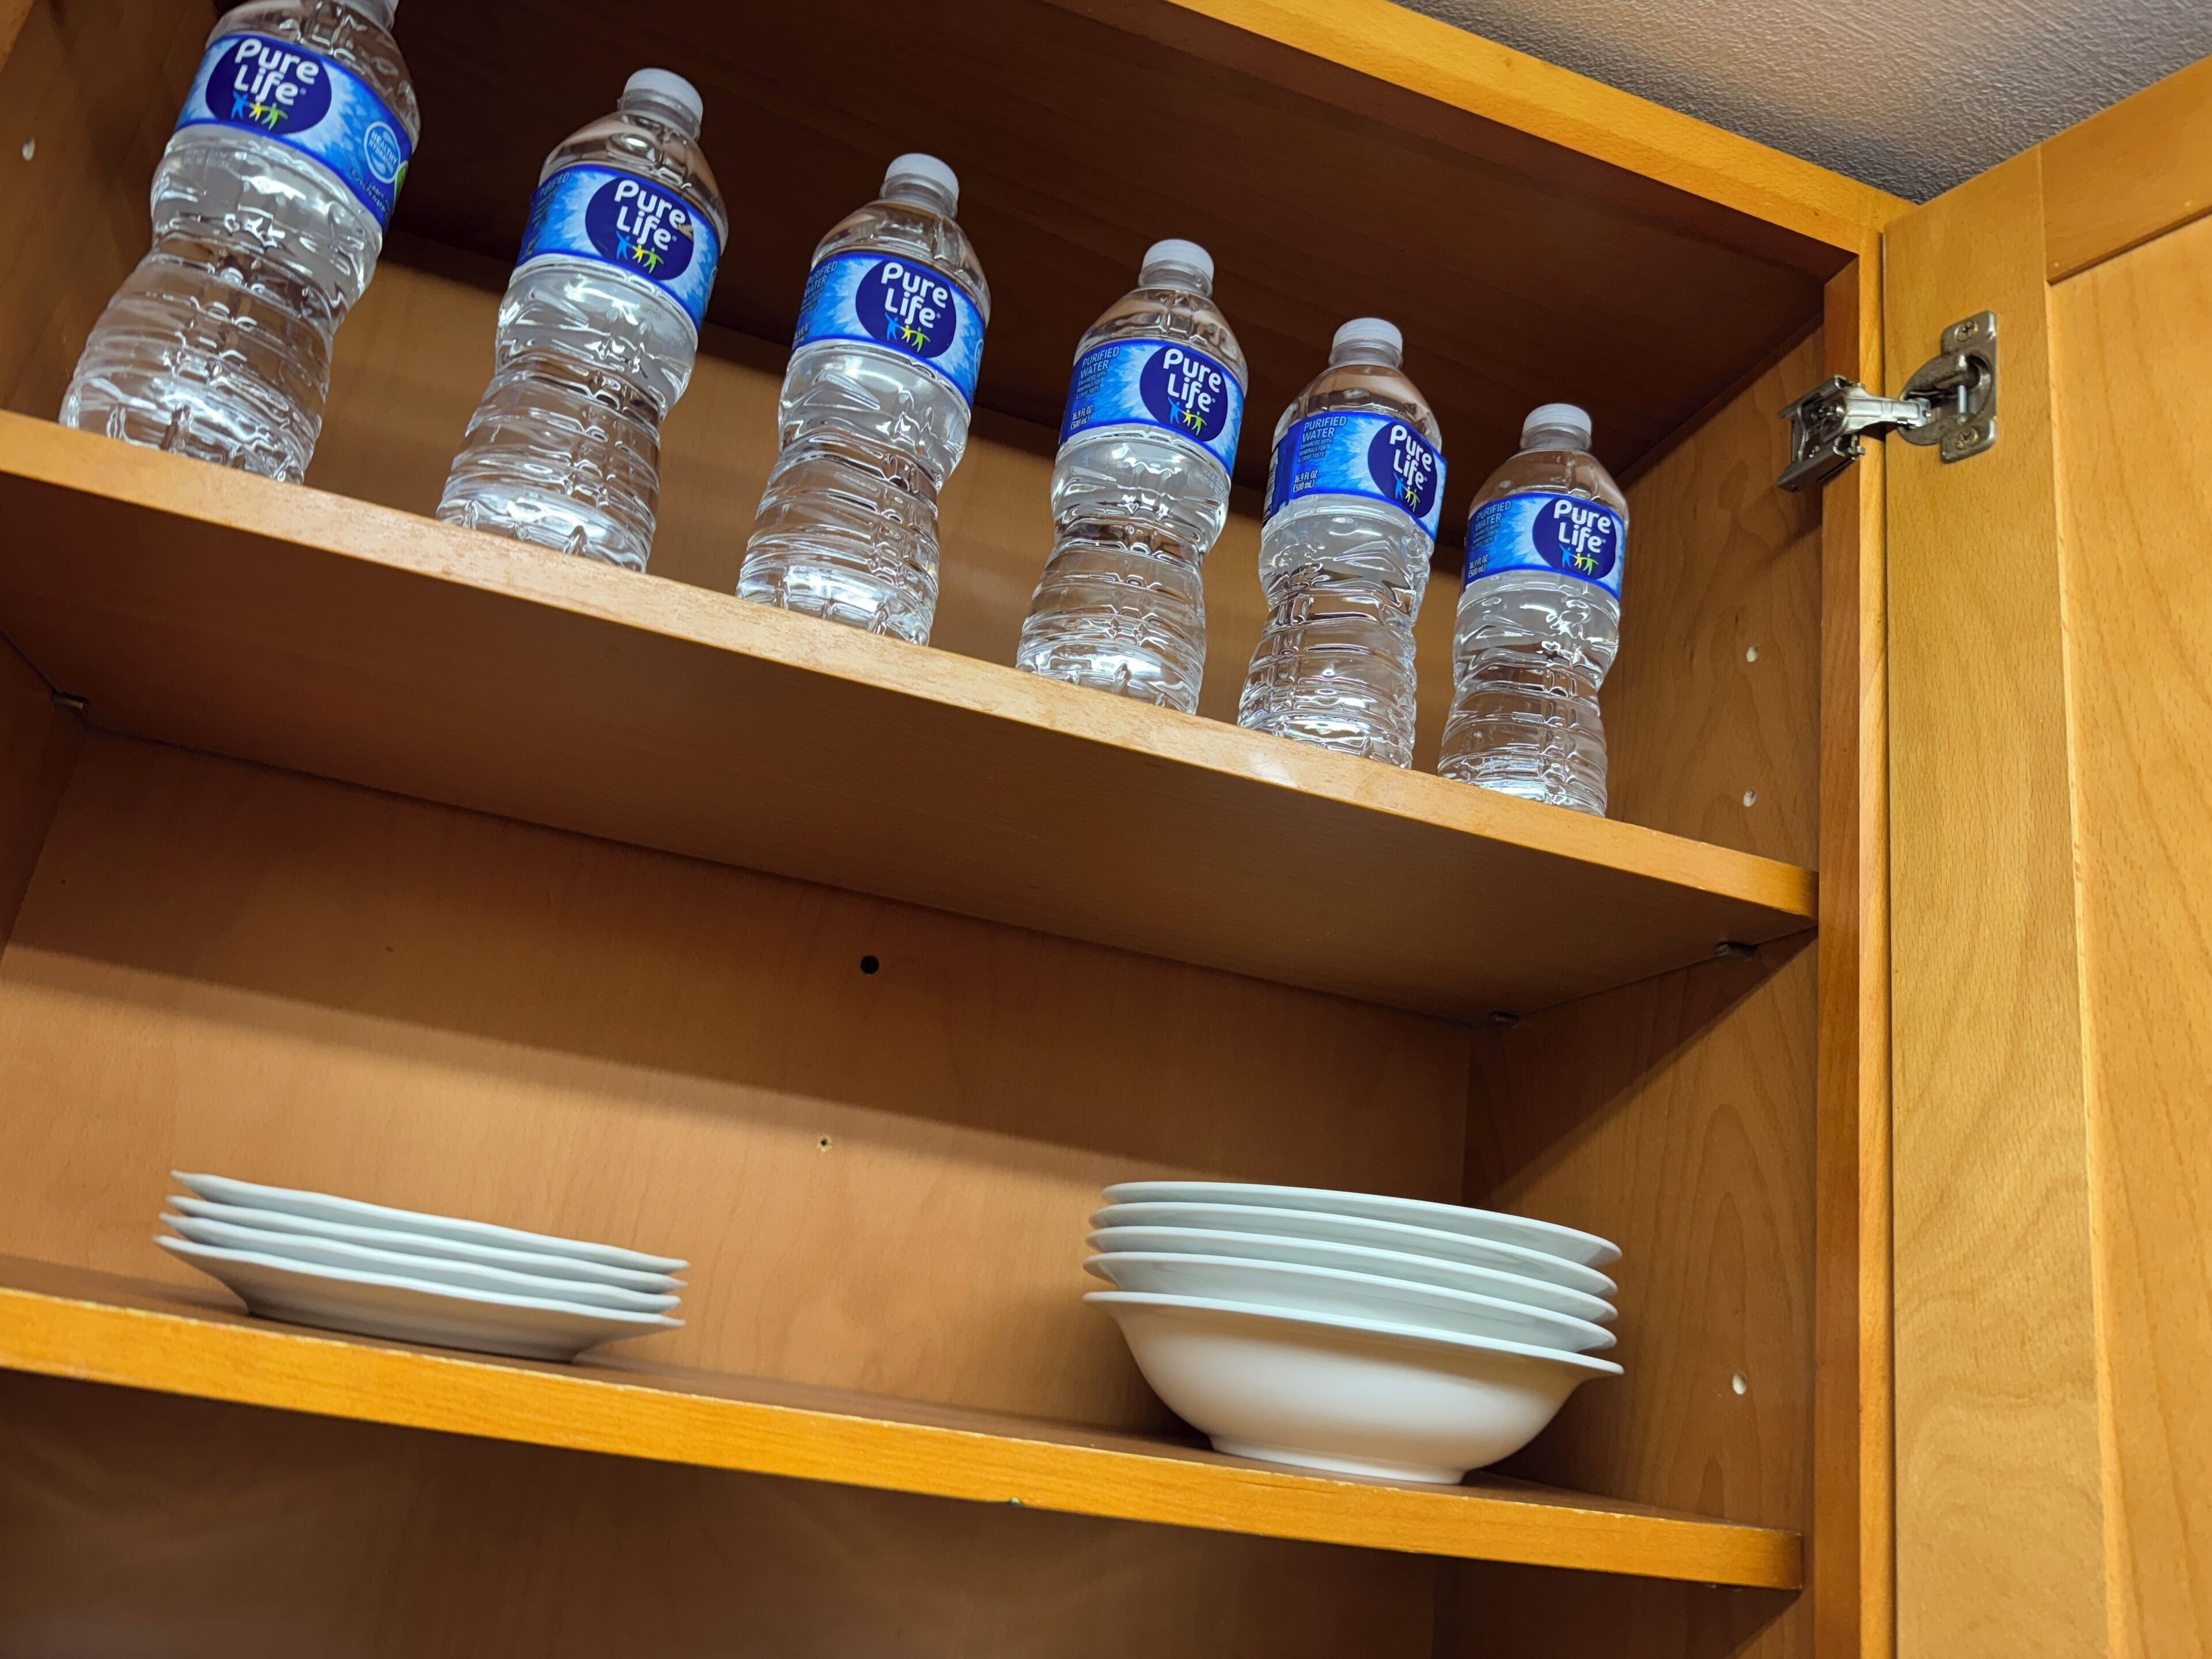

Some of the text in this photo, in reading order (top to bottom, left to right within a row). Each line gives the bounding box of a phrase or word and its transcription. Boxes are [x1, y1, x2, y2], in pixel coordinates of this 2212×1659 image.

[234, 39, 320, 85] Pure
[234, 65, 300, 105] Life
[372, 130, 398, 165] HEALTHY
[614, 179, 686, 229] Pure
[616, 206, 671, 251] Life
[806, 261, 838, 287] PURIFIED
[881, 262, 948, 308] Pure
[884, 287, 935, 328] Life
[1080, 359, 1109, 379] WATER
[1082, 346, 1120, 369] PURIFIED
[1163, 348, 1222, 393] Pure
[1167, 374, 1211, 412] Life
[1302, 427, 1335, 442] WATER
[1304, 416, 1347, 432] PURIFIED
[1389, 425, 1433, 472] Pure
[1304, 471, 1310, 480] FL
[1310, 469, 1318, 479] OZ
[1393, 449, 1424, 491] Life
[1475, 513, 1502, 531] WATER
[1476, 501, 1512, 522] PURIFIED
[1554, 499, 1611, 534] Pure
[1558, 522, 1603, 553] Life
